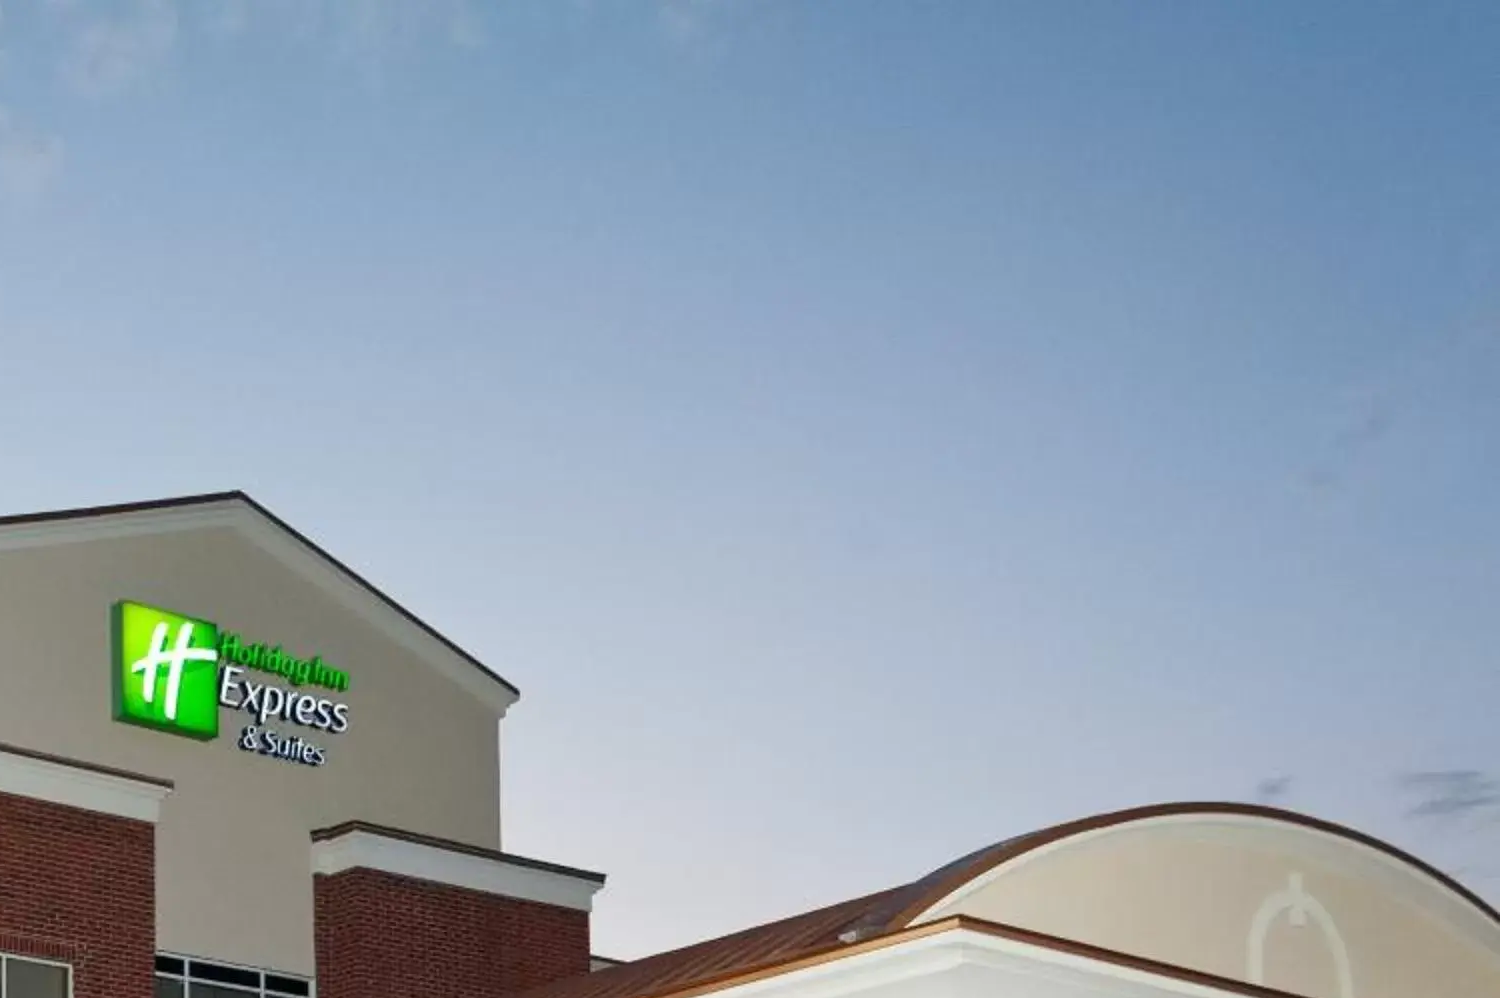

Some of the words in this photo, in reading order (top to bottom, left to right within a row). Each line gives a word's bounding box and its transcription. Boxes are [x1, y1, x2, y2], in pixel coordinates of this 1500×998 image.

[218, 631, 312, 686] Holiday
[311, 655, 350, 692] Inn
[218, 665, 350, 733] Express
[241, 725, 259, 751] &
[264, 731, 325, 766] Suites
